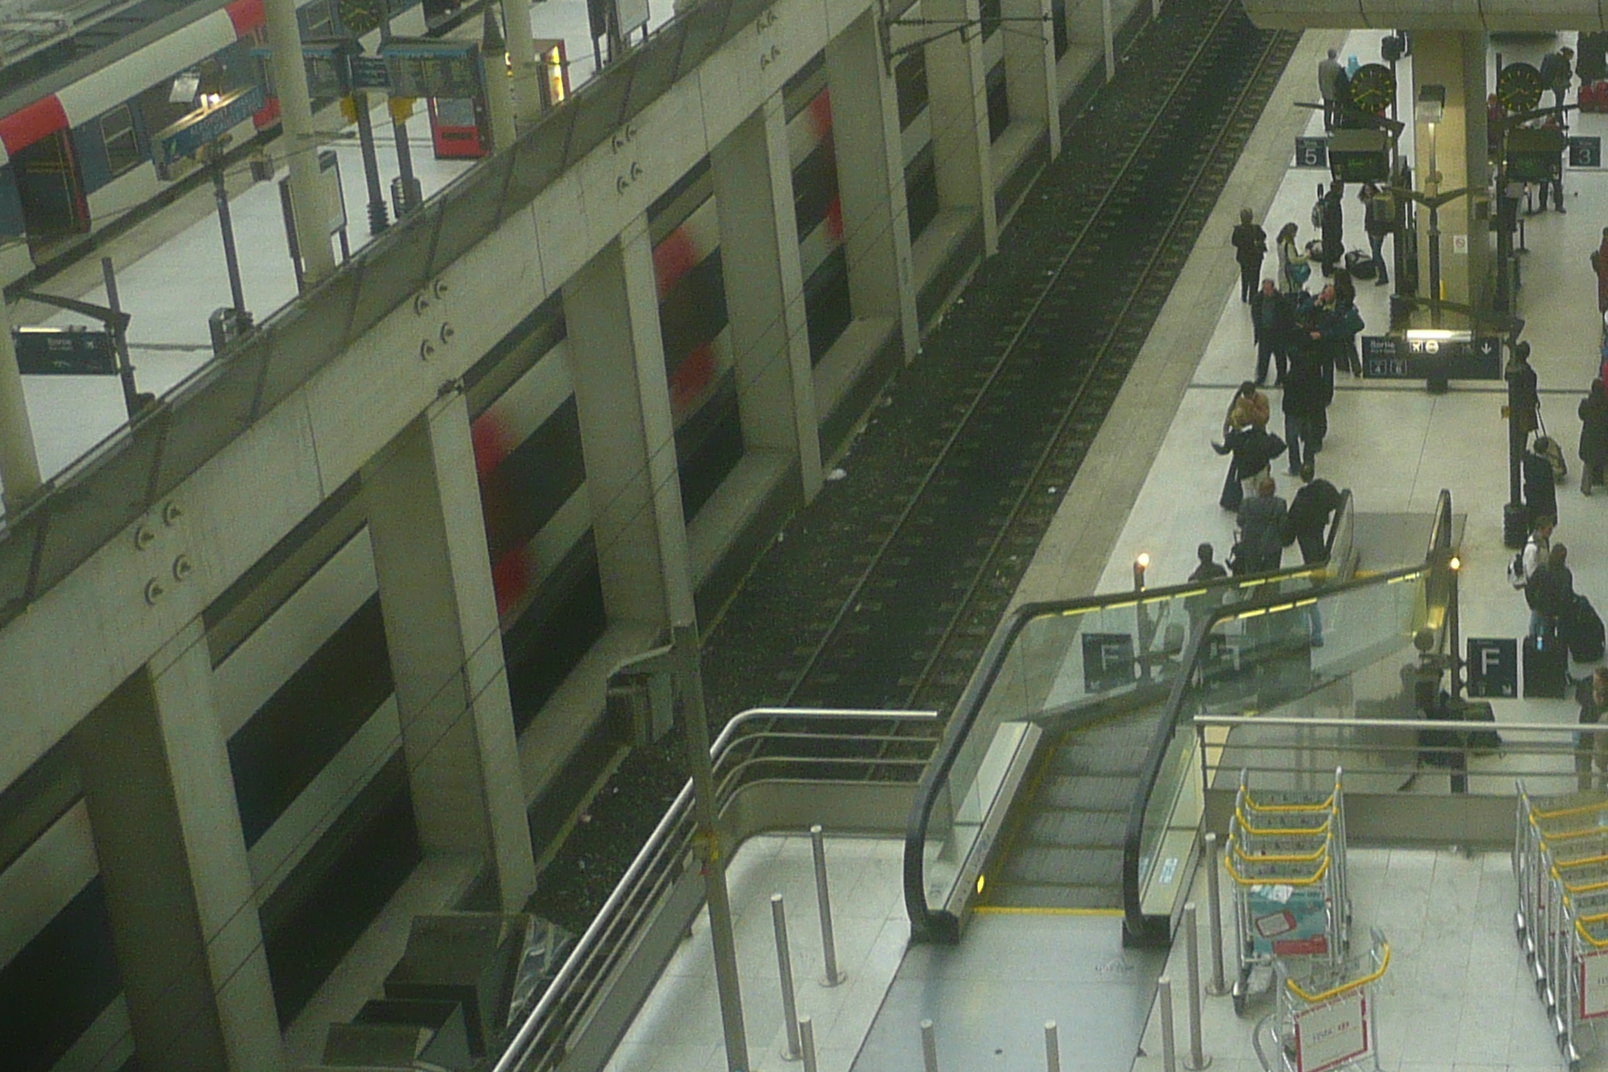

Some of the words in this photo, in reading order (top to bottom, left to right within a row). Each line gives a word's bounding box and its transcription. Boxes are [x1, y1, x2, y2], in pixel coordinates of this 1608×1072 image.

[1305, 148, 1317, 165] 5
[1578, 148, 1591, 165] 3
[1101, 644, 1119, 670] F
[1482, 648, 1500, 675] F
